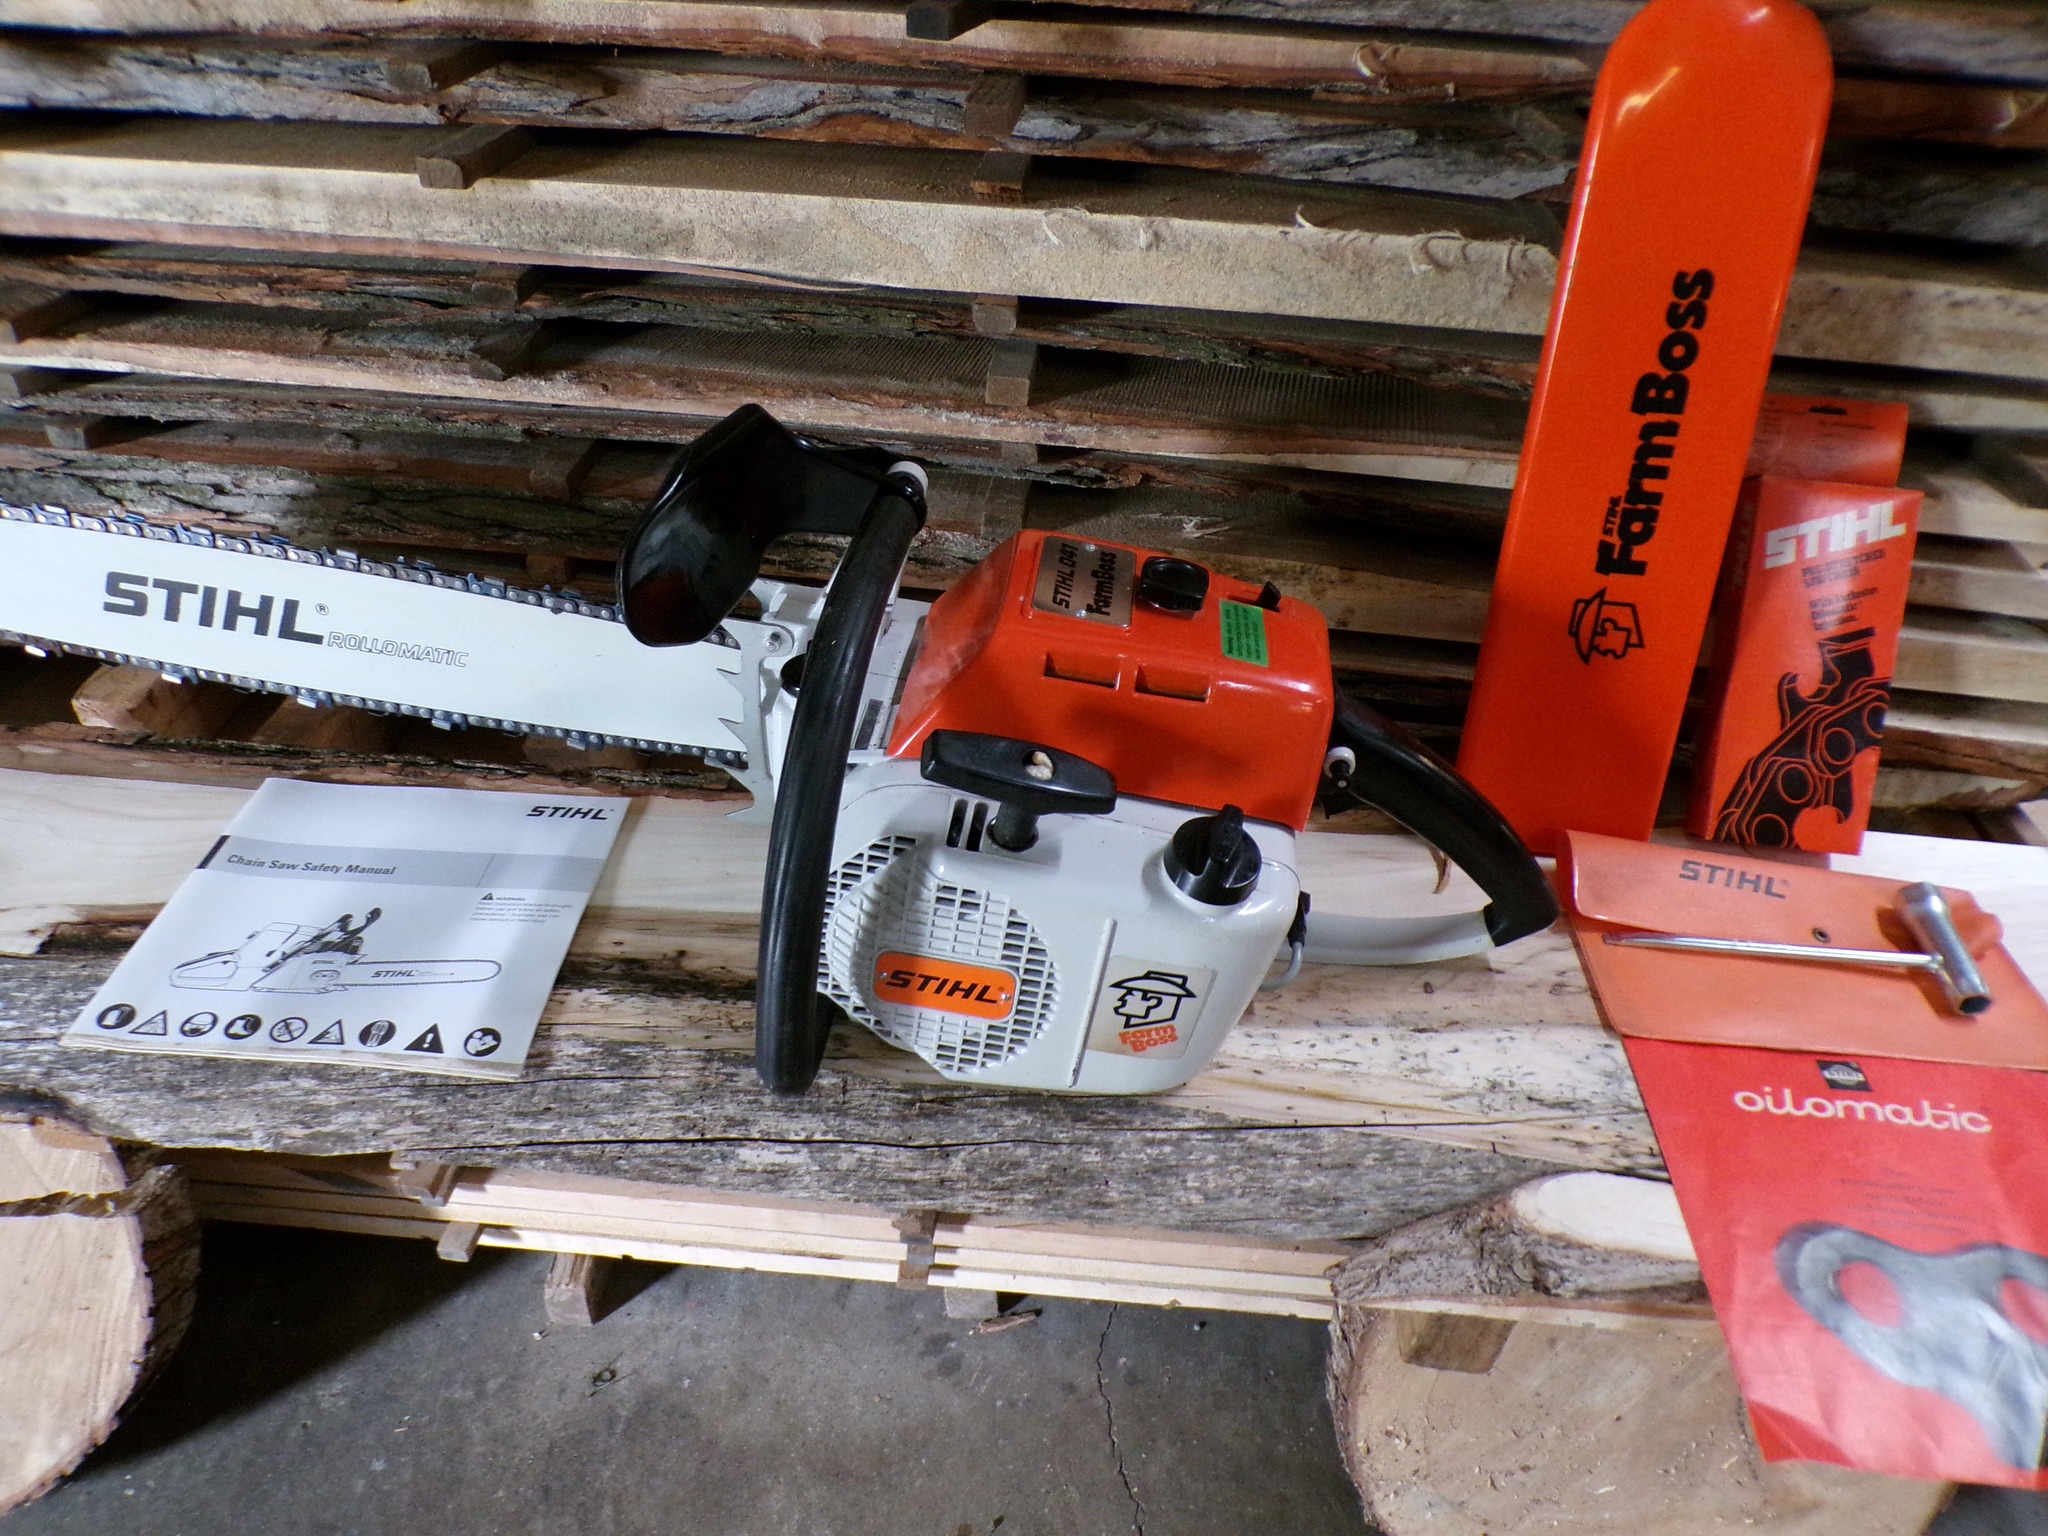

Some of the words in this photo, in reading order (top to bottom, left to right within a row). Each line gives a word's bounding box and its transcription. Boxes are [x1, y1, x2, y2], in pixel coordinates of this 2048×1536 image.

[1764, 500, 1906, 569] STIHL
[1058, 542, 1079, 569] 041
[1052, 569, 1075, 609] STIHL
[327, 632, 469, 668] ROLLOMATIC
[525, 806, 608, 821] STIHL
[227, 854, 266, 868] Chain
[268, 860, 300, 870] Saw
[301, 862, 344, 874] Safety
[344, 864, 397, 875] Manual
[1679, 859, 1786, 899] STIHL
[371, 969, 415, 978] STIHL
[885, 969, 999, 1004] STIHL
[1119, 1024, 1177, 1045] Farm
[1129, 1033, 1179, 1053] Boss
[1734, 1086, 1993, 1134] oilomatic
